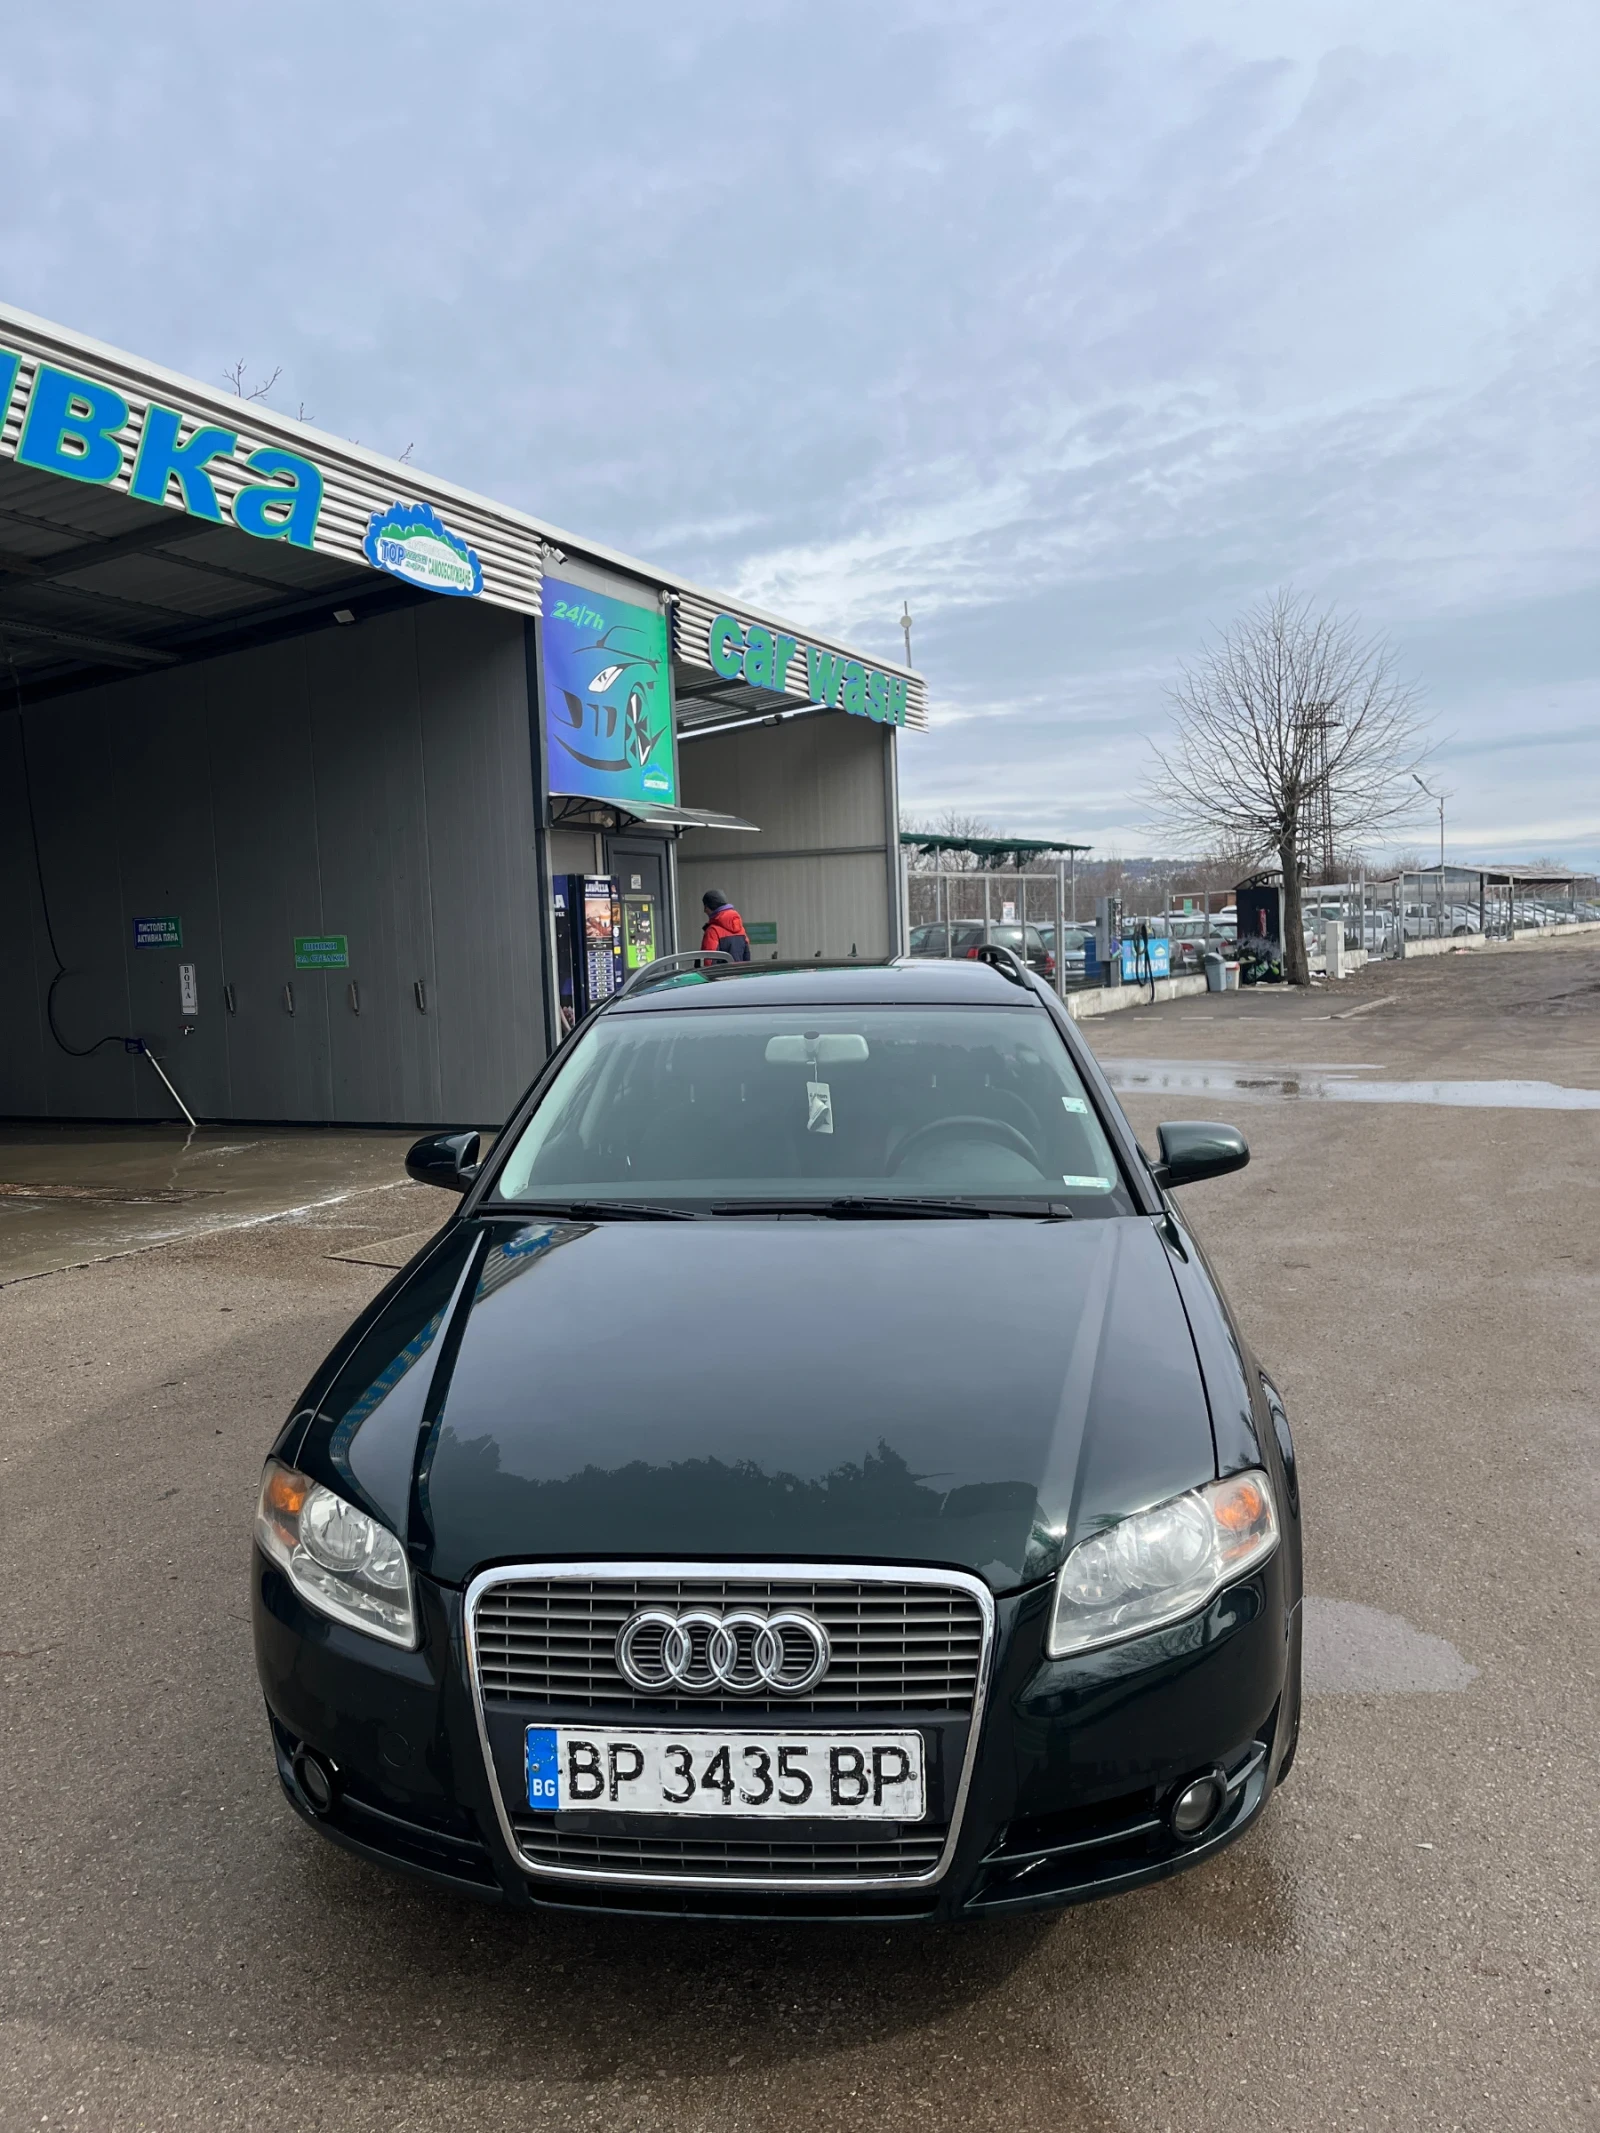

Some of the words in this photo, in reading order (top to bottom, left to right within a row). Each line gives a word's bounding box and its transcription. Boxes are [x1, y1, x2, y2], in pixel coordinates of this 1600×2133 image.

[380, 539, 405, 566] TOP
[709, 613, 795, 692] car
[138, 922, 167, 932] ПИСТОЛЕТ
[168, 922, 176, 931] ЗА
[137, 934, 162, 943] АКТИВНА
[163, 933, 179, 942] ПЯНА
[303, 942, 337, 951] ЩИПКИ
[310, 954, 346, 962] СТЕЛКИ
[183, 966, 192, 999] ВОДА
[567, 1740, 644, 1803] BP
[662, 1744, 813, 1807] 3435
[829, 1746, 912, 1807] BP
[533, 1779, 556, 1797] BG
